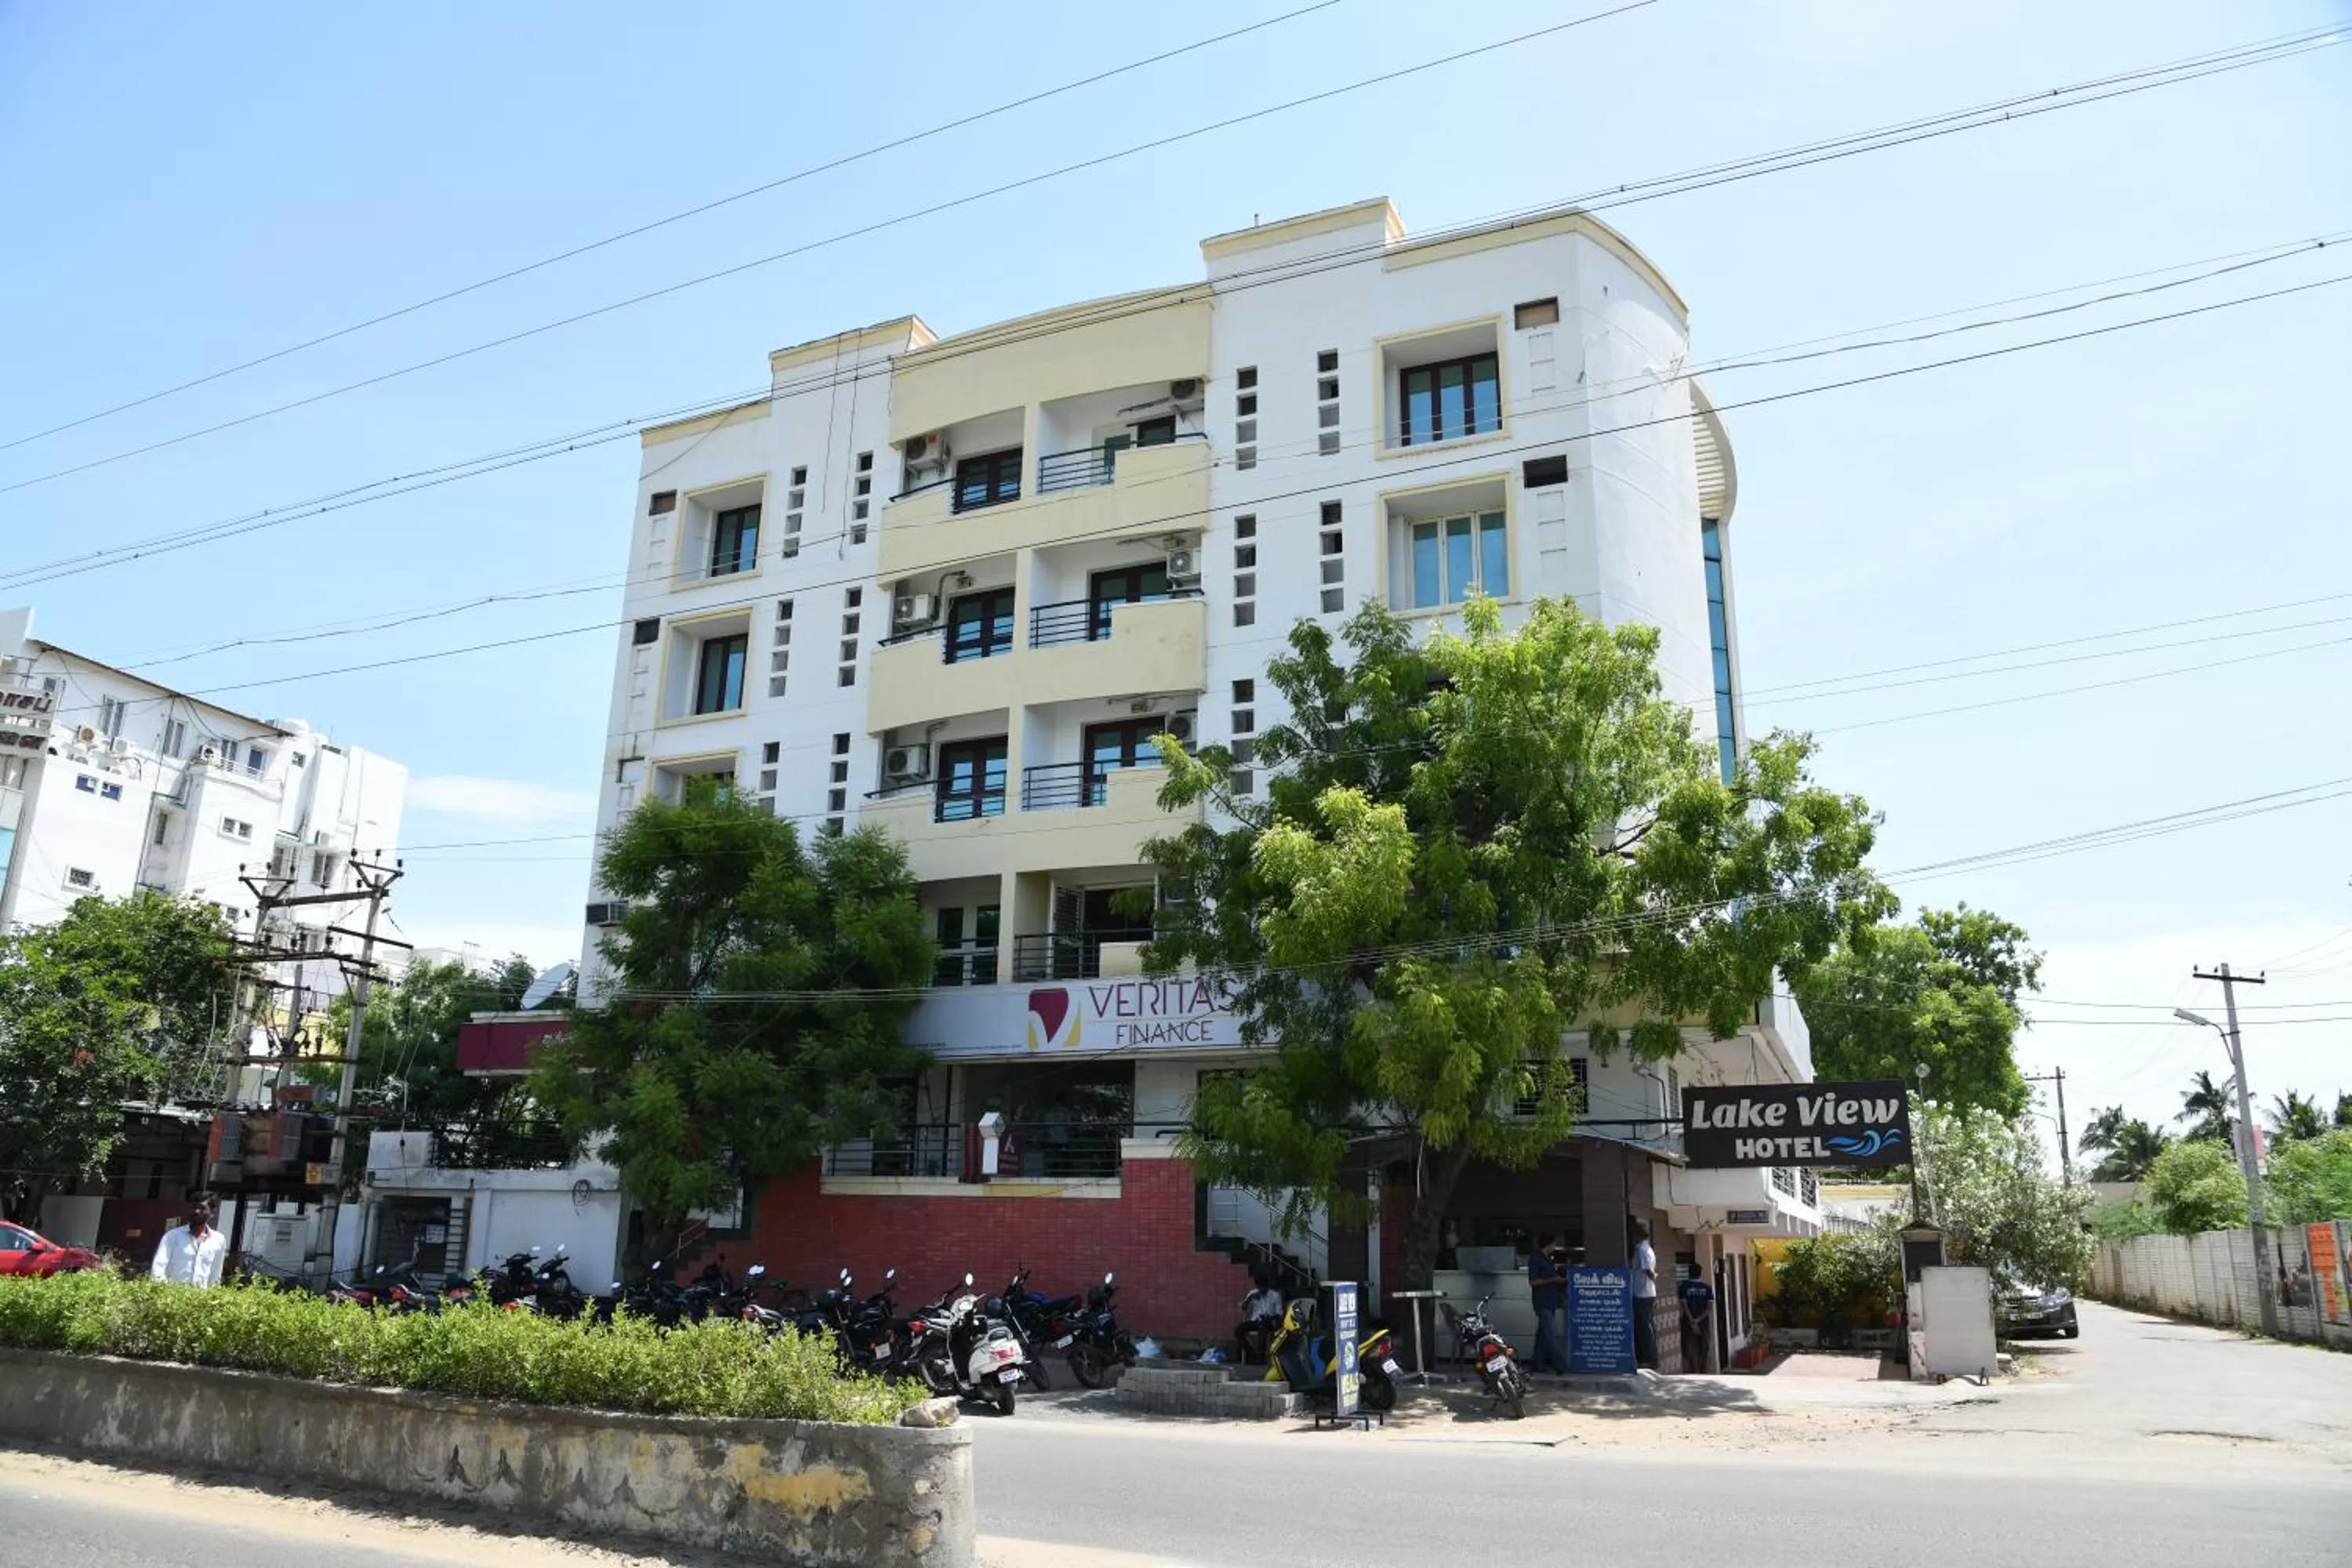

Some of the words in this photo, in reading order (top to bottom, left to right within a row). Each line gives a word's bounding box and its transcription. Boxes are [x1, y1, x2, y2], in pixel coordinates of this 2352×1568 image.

[1088, 977, 1239, 1018] VERITAS
[1116, 1021, 1214, 1044] FINANCE
[1692, 1098, 1787, 1130] Lake
[1796, 1092, 1899, 1126] View
[1735, 1137, 1831, 1160] HOTEL
